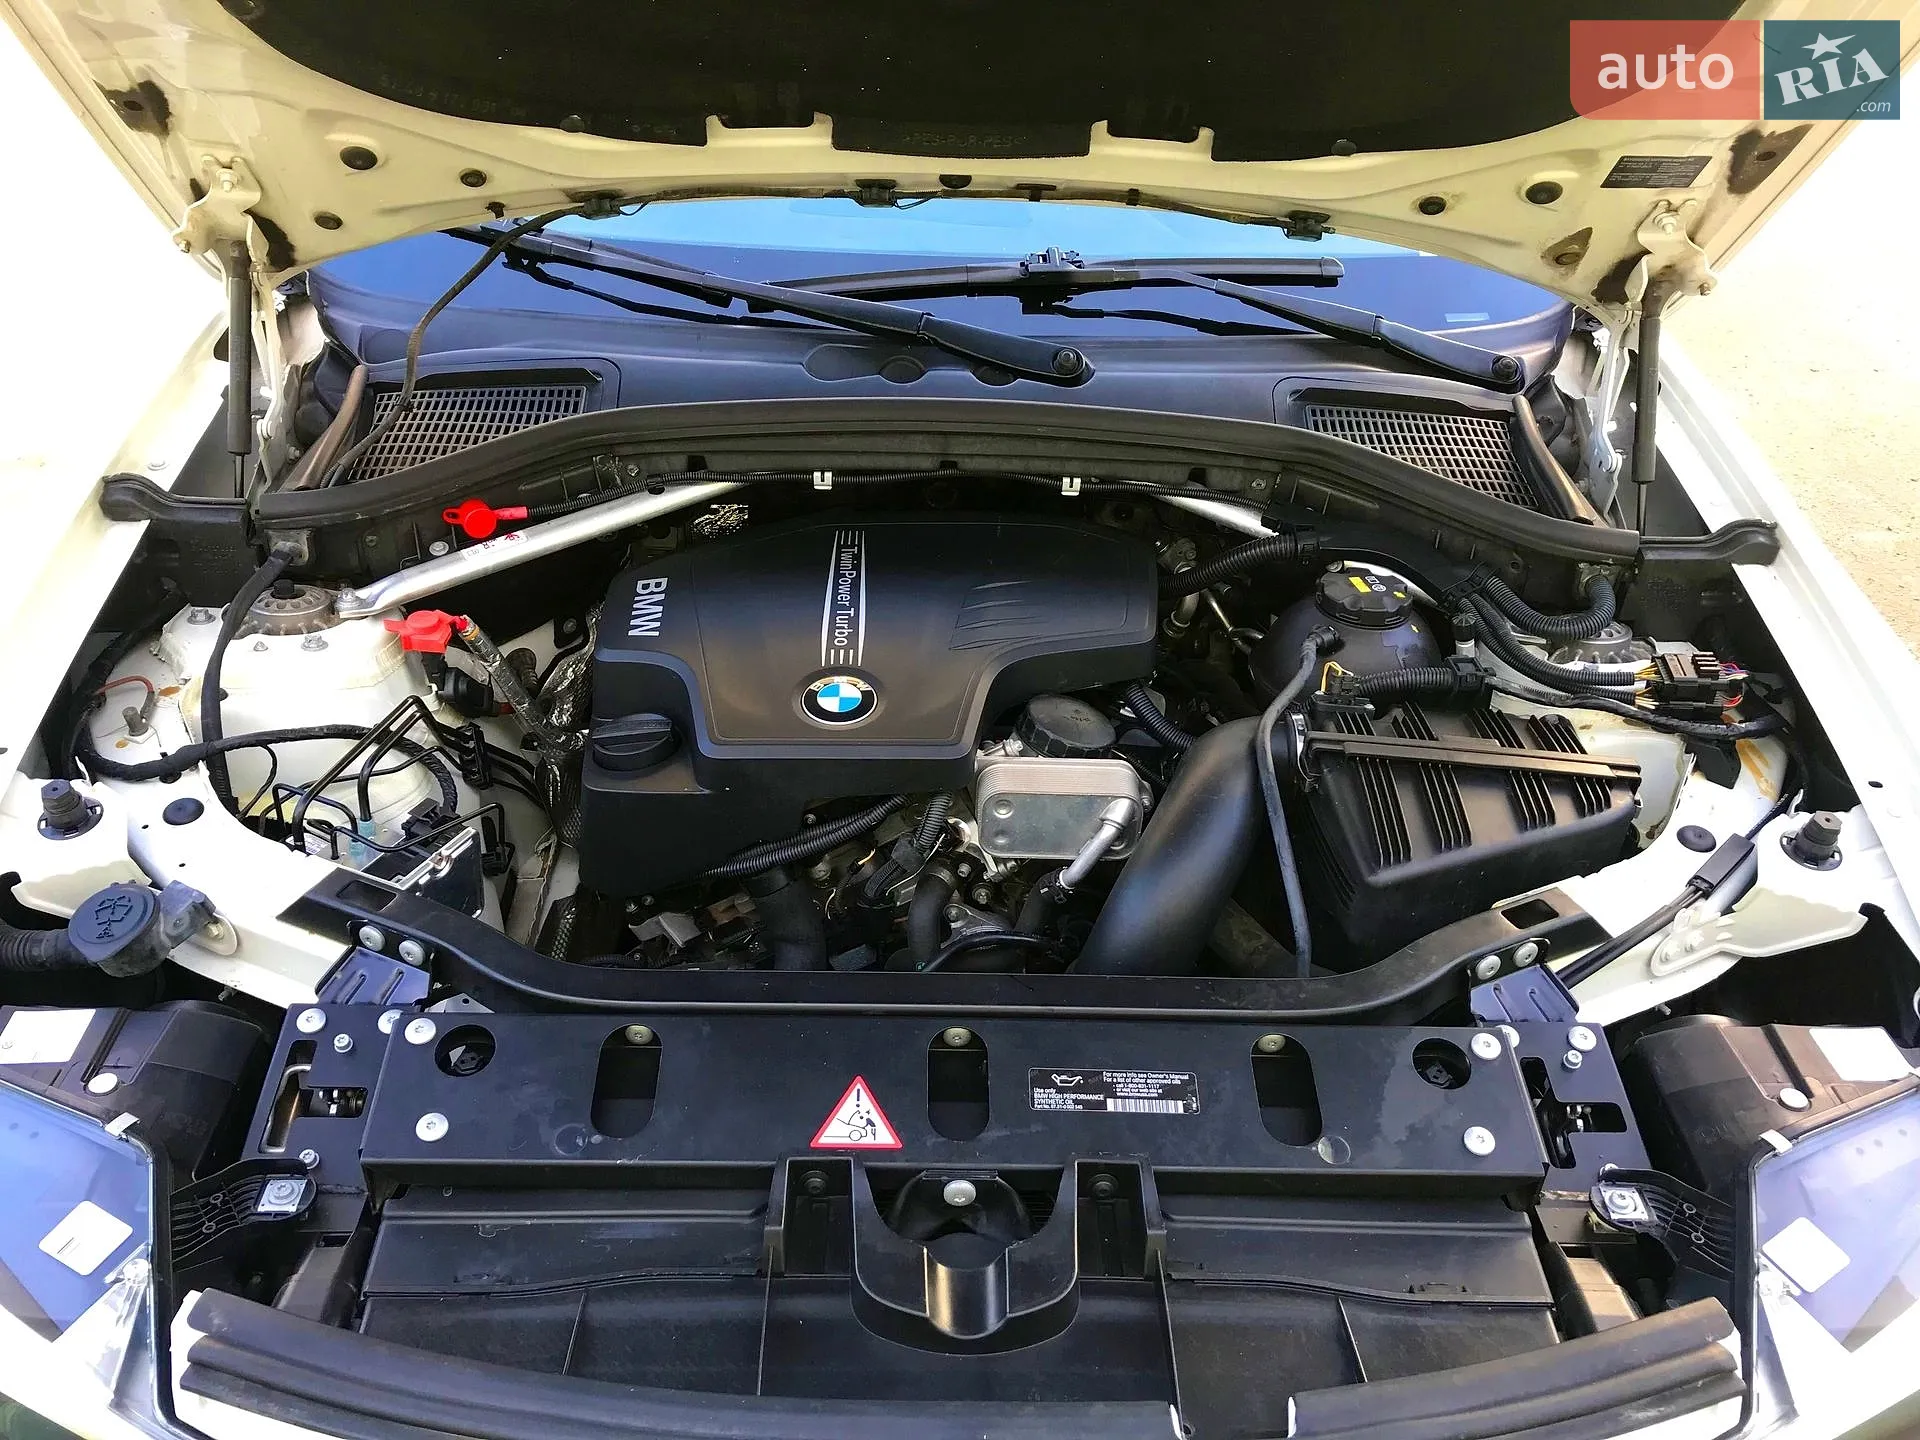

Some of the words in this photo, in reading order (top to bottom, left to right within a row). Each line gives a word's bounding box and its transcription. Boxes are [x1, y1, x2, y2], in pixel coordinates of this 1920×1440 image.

[835, 546, 858, 606] TwinPower
[627, 577, 669, 638] BMW
[834, 608, 857, 647] Turbo
[1044, 1087, 1057, 1095] only
[1063, 1093, 1105, 1101] PERFORMANCE
